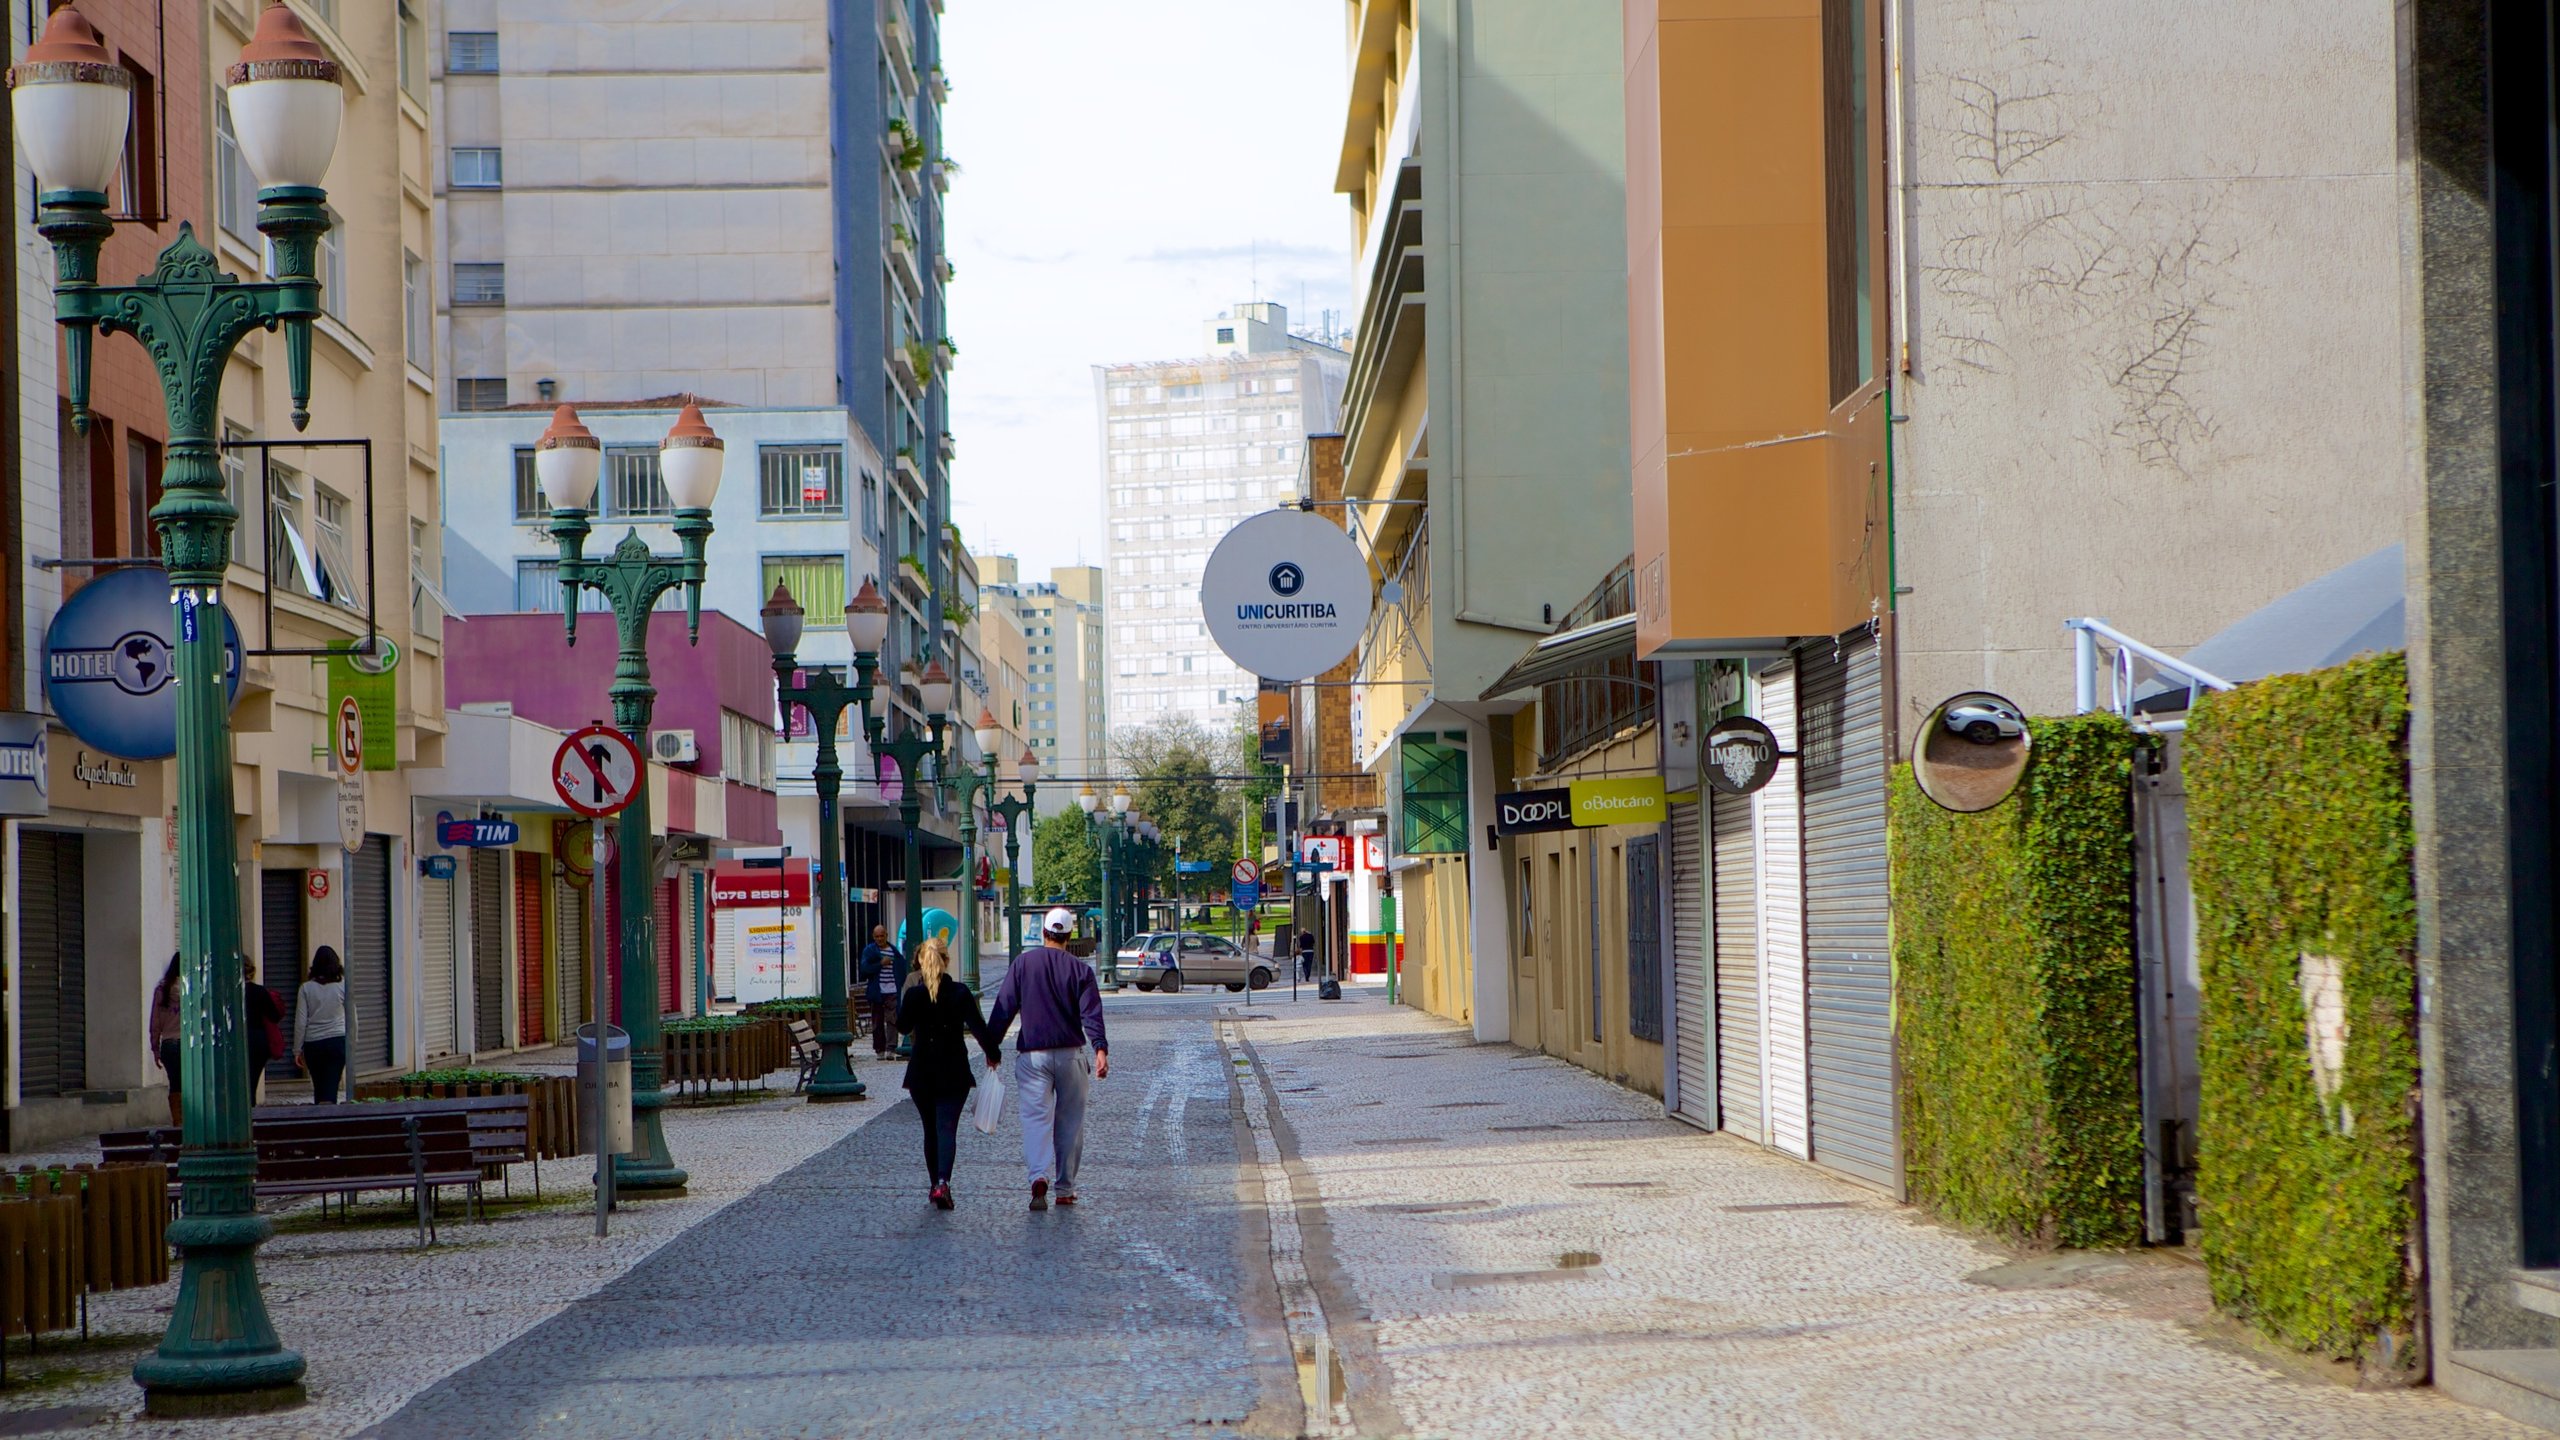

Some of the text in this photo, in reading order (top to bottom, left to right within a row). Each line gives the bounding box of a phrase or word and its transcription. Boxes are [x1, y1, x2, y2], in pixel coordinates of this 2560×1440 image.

[1237, 603, 1337, 620] UNICURITIBA
[51, 653, 116, 677] HOTEL
[76, 751, 137, 789] Superbonita
[476, 825, 510, 841] TIM
[783, 907, 802, 916] 209
